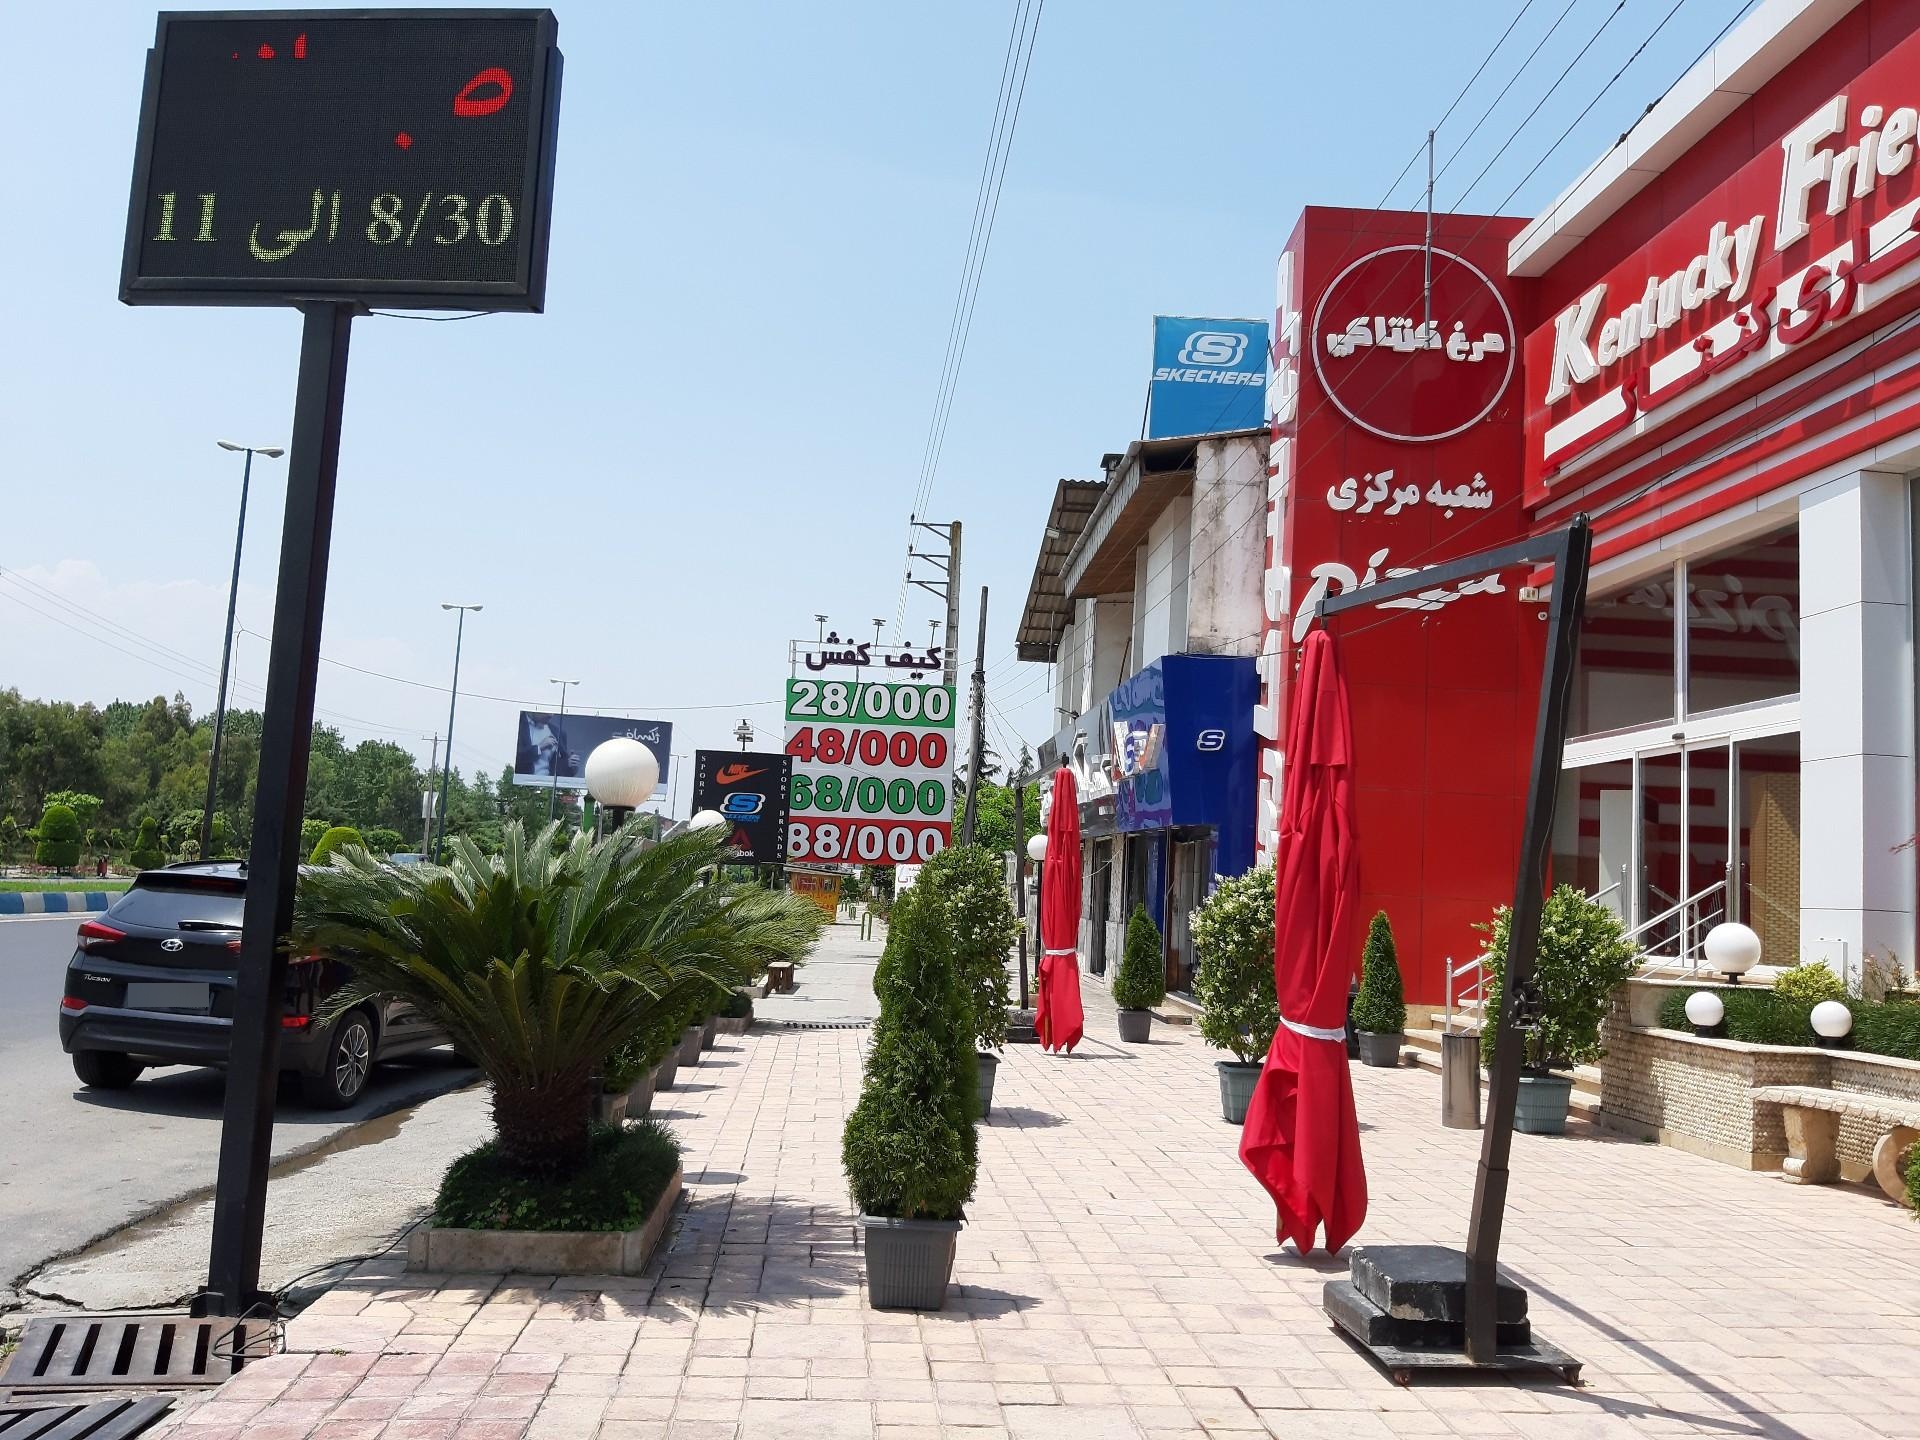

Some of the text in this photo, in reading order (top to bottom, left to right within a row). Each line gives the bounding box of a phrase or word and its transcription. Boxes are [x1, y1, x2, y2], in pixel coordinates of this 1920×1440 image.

[151, 187, 516, 262] 8/30 الی 11
[1544, 95, 1920, 406] Kentucky Frie
[1444, 319, 1505, 362] مرغ
[1152, 366, 1265, 387] SKECHERS
[1326, 469, 1493, 519] شعبه مرکزی
[805, 631, 942, 680] کیف کفش
[789, 680, 951, 721] 28/000
[785, 727, 948, 768] 48/000
[698, 755, 707, 796] SPORT
[789, 774, 946, 815] 68/000
[776, 759, 788, 859] SPORT BRANDS
[788, 823, 944, 862] 88/000
